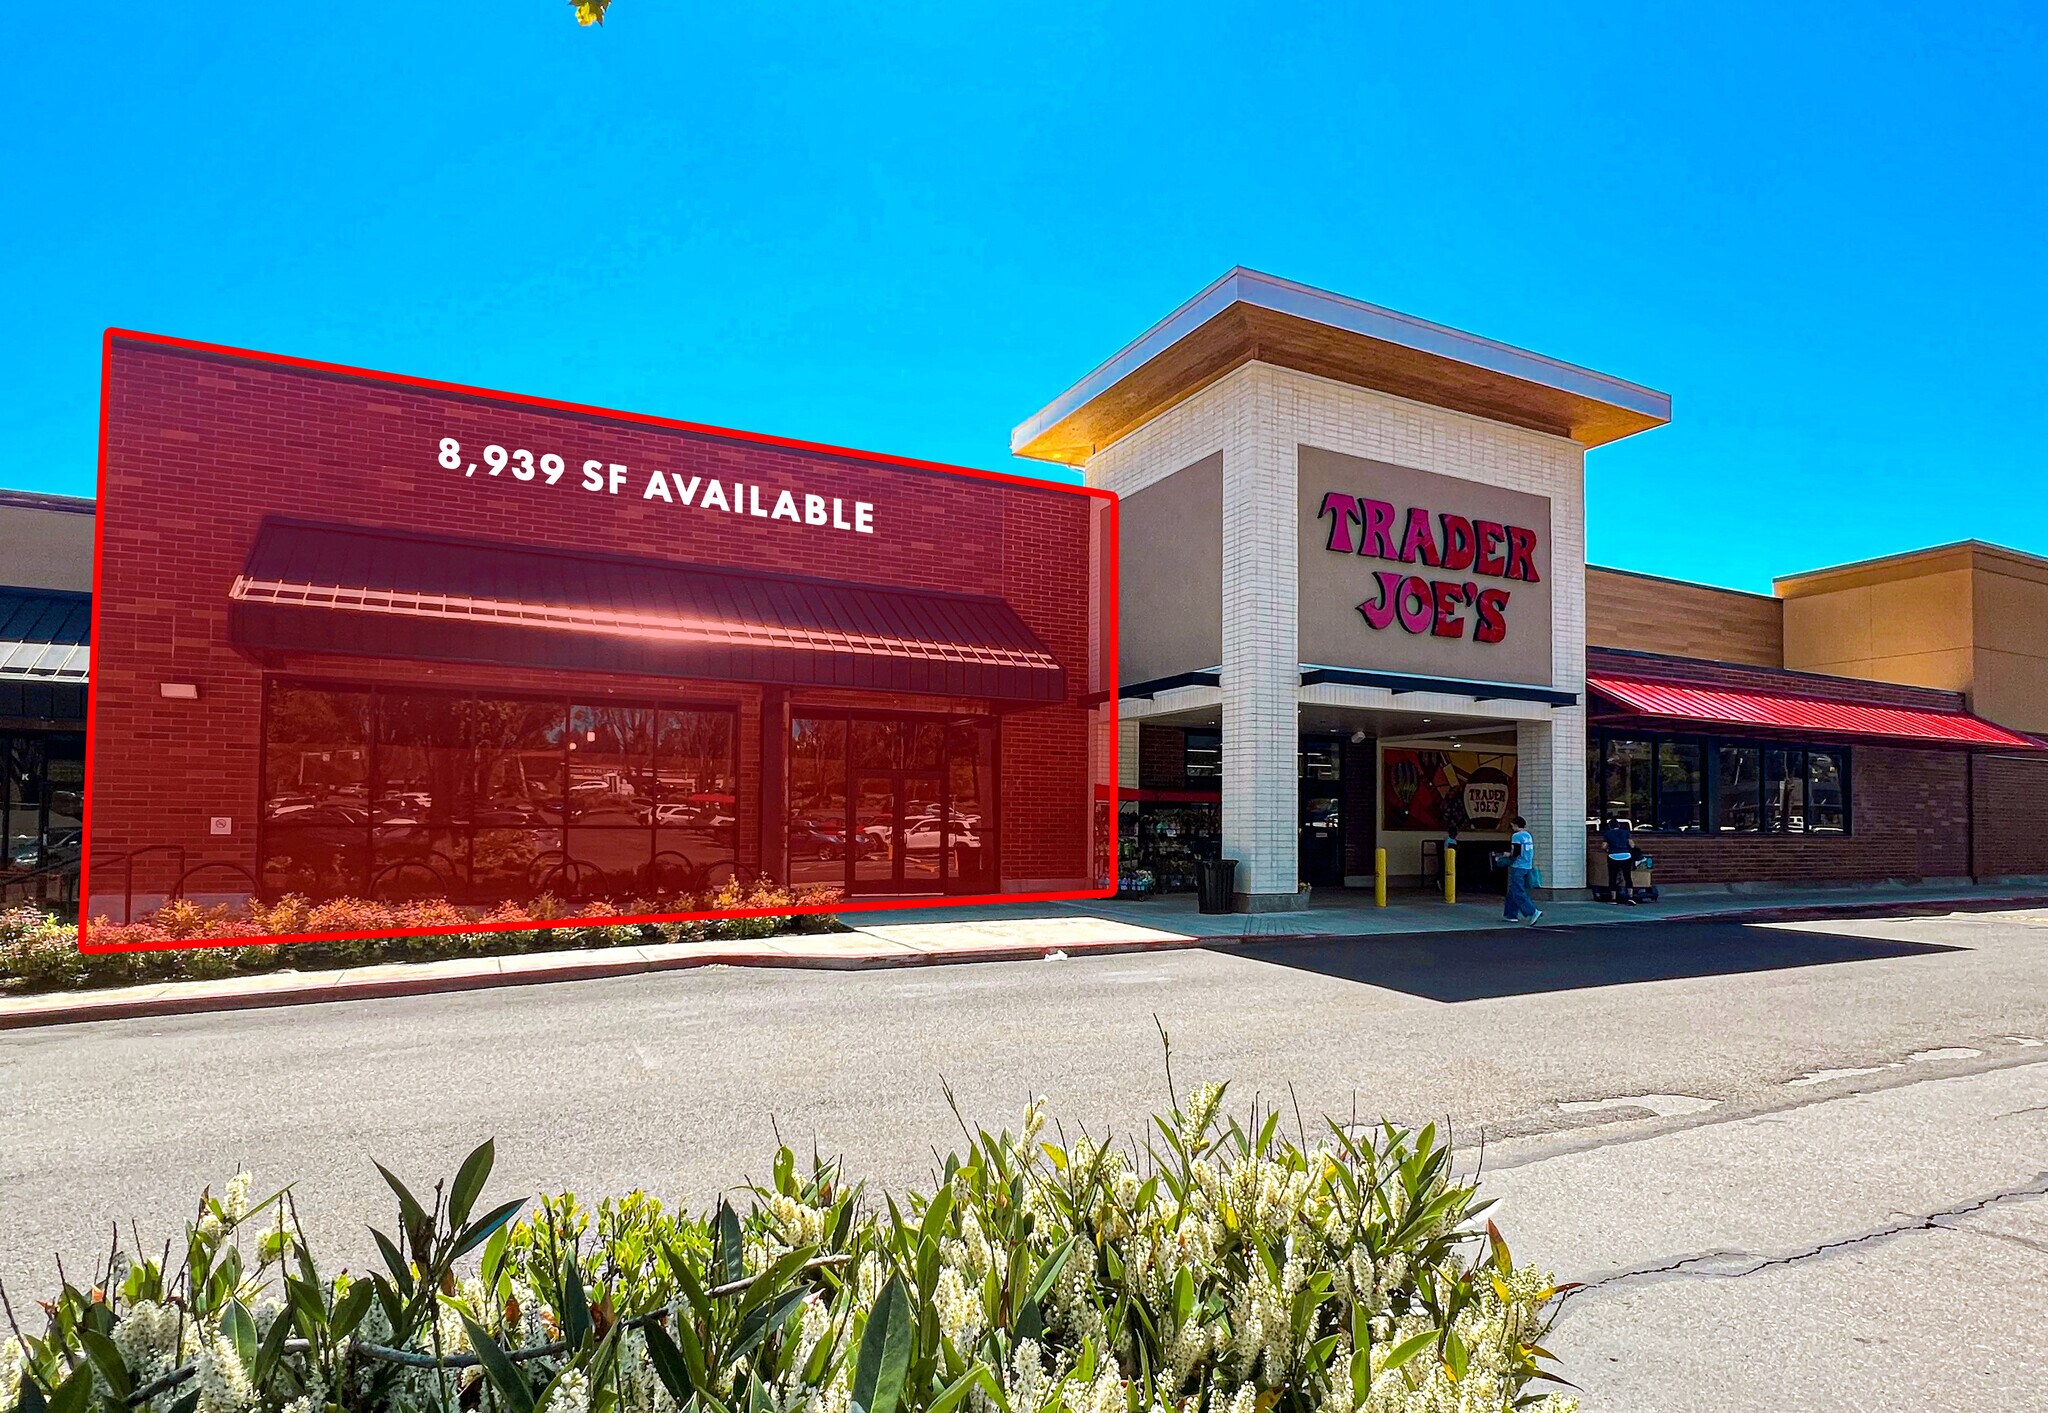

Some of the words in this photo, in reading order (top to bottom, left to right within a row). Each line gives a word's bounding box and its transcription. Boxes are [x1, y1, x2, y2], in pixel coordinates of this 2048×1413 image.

[1317, 492, 1540, 582] TRADER
[1355, 571, 1511, 643] JOE'S
[1469, 789, 1506, 802] TRADER
[1474, 801, 1499, 813] JOE'S
